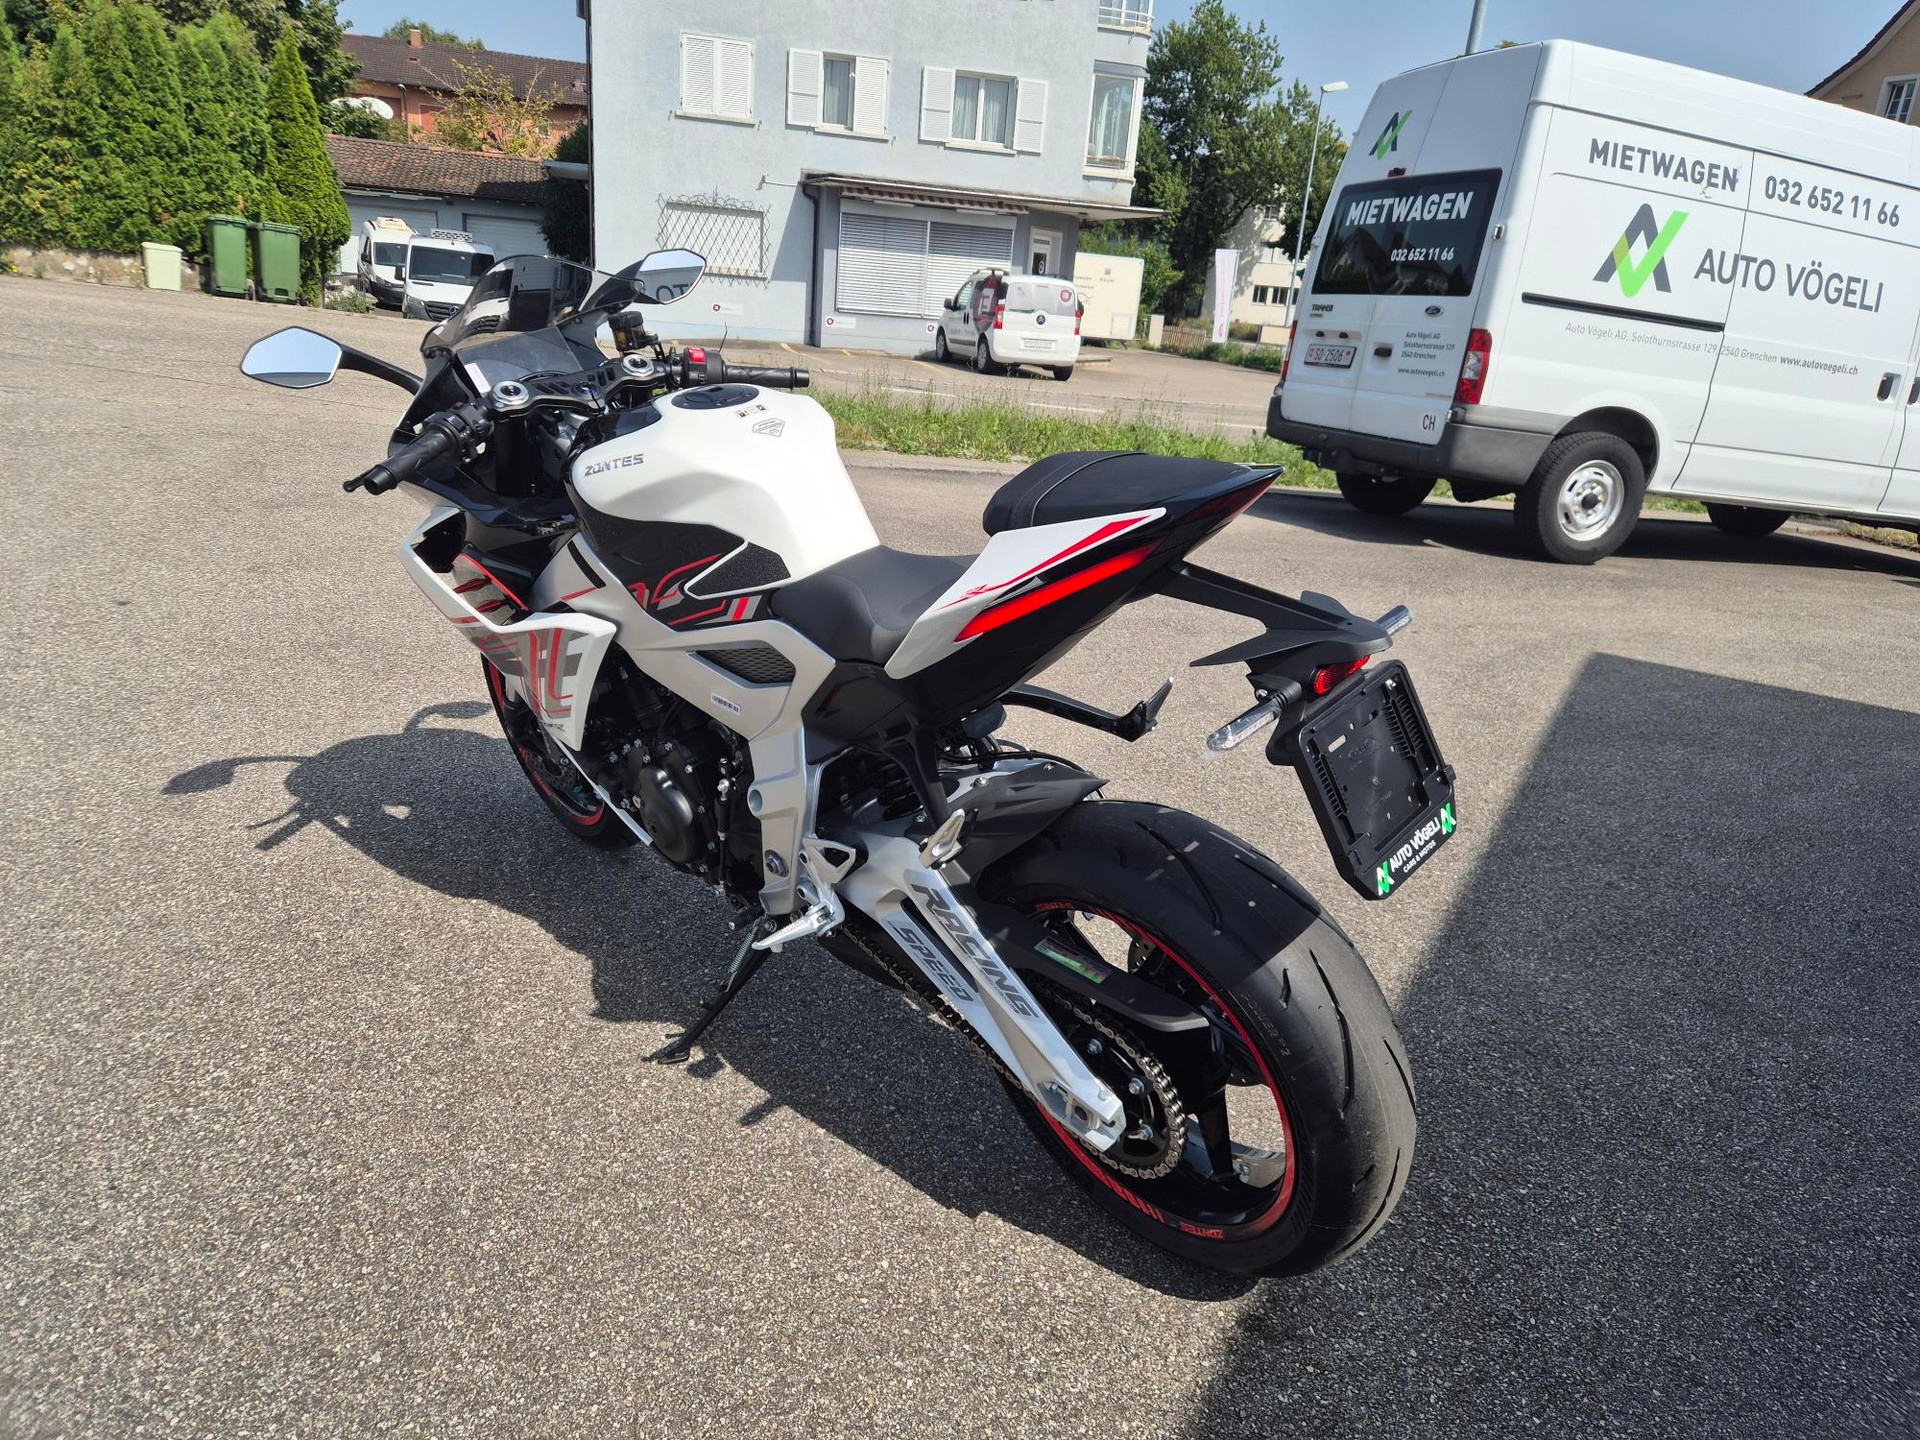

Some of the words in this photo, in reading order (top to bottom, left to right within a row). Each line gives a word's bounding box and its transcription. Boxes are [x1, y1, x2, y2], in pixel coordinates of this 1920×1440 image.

[1589, 138, 1738, 193] MIETWAGEN
[1345, 191, 1474, 226] MIETWAGEN
[1764, 175, 1803, 206] 032
[1807, 185, 1844, 216] 652
[1850, 195, 1872, 222] 11
[1876, 201, 1900, 228] 66
[1390, 249, 1407, 262] 032
[1408, 248, 1429, 261] 652
[1428, 248, 1440, 261] 11
[1441, 247, 1455, 261] 66
[1693, 248, 1776, 292] AUTO
[1785, 260, 1885, 313] VÖGELI
[1405, 331, 1417, 339] Auto
[1565, 322, 1586, 334] Auto
[1587, 325, 1613, 339] Vögeli
[1632, 332, 1701, 352] Solothurnstrasse
[1720, 345, 1740, 358] 2540
[1741, 348, 1778, 363] Grenchen
[1780, 355, 1859, 376] www.autovoegeli.ch
[1422, 414, 1437, 431] CH
[584, 453, 645, 477] ZONTES
[1389, 843, 1413, 873] AUTO
[1410, 817, 1441, 850] VÖGELI
[1403, 858, 1417, 873] CARS
[1419, 840, 1437, 858] MOTOS
[892, 926, 974, 1002] SPEED
[910, 884, 1040, 1018] RACING
[1180, 1221, 1225, 1239] ZONTES
